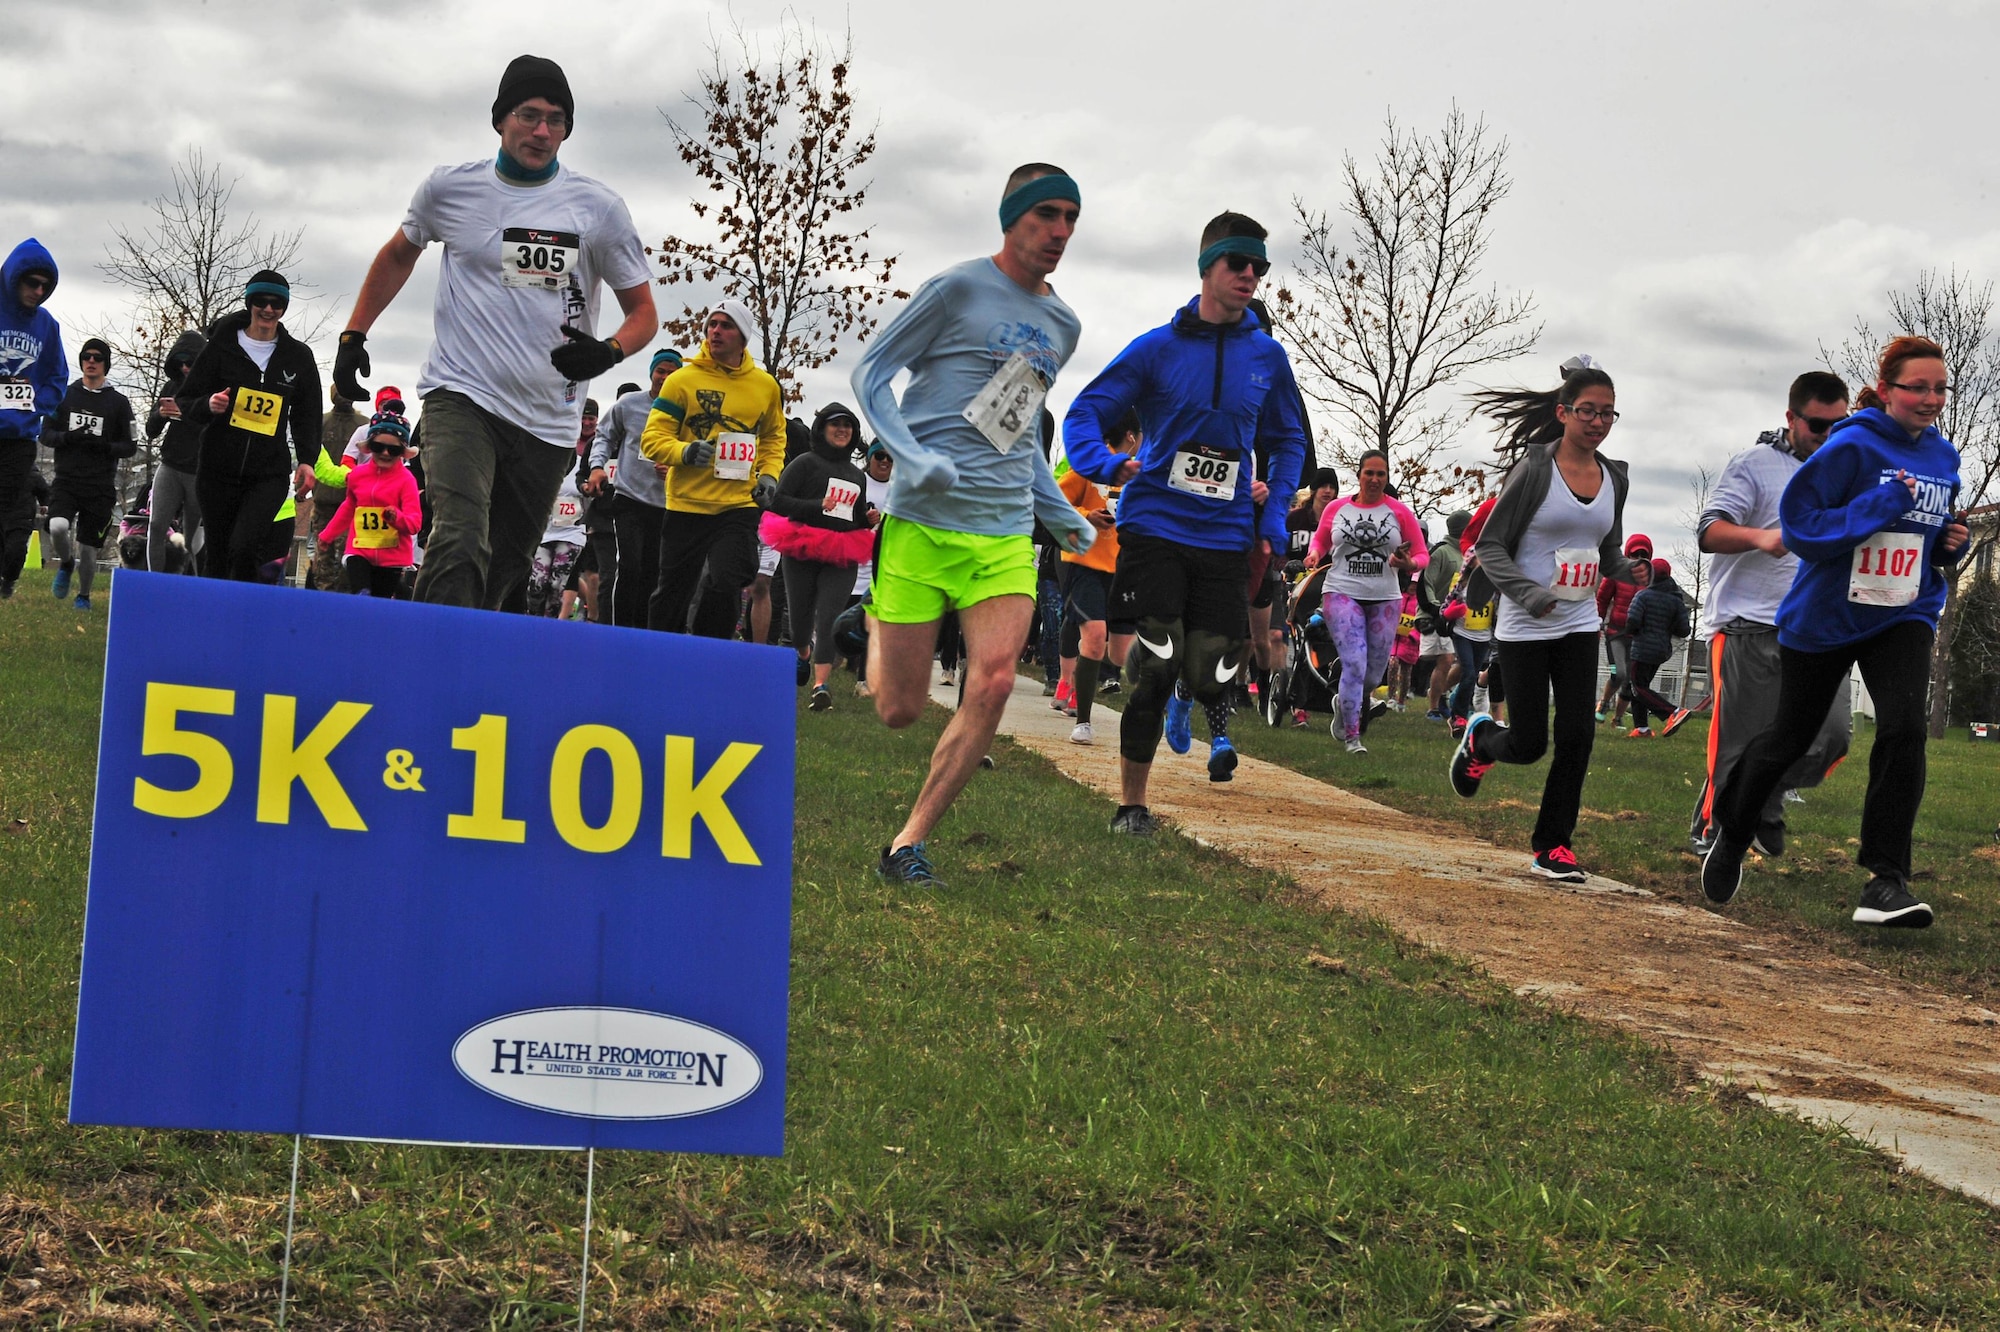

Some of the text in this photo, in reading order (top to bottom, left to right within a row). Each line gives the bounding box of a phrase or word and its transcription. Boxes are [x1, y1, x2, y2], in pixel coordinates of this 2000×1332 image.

[516, 245, 565, 273] 305
[1, 330, 37, 343] MEMORIAL
[4, 386, 32, 399] 327
[243, 395, 274, 416] 132
[76, 415, 98, 428] 316
[719, 442, 755, 462] 1132
[1184, 456, 1229, 482] 308
[830, 487, 858, 506] 1114
[560, 504, 576, 515] 725
[1348, 561, 1383, 574] FREEDOM
[1858, 546, 1919, 577] 1107
[1557, 562, 1597, 587] 1151
[133, 681, 764, 866] 5K & 10K
[491, 1039, 727, 1087] HEALTH PROMOTION
[546, 1063, 677, 1080] UNITED STATES AIR FORCE
